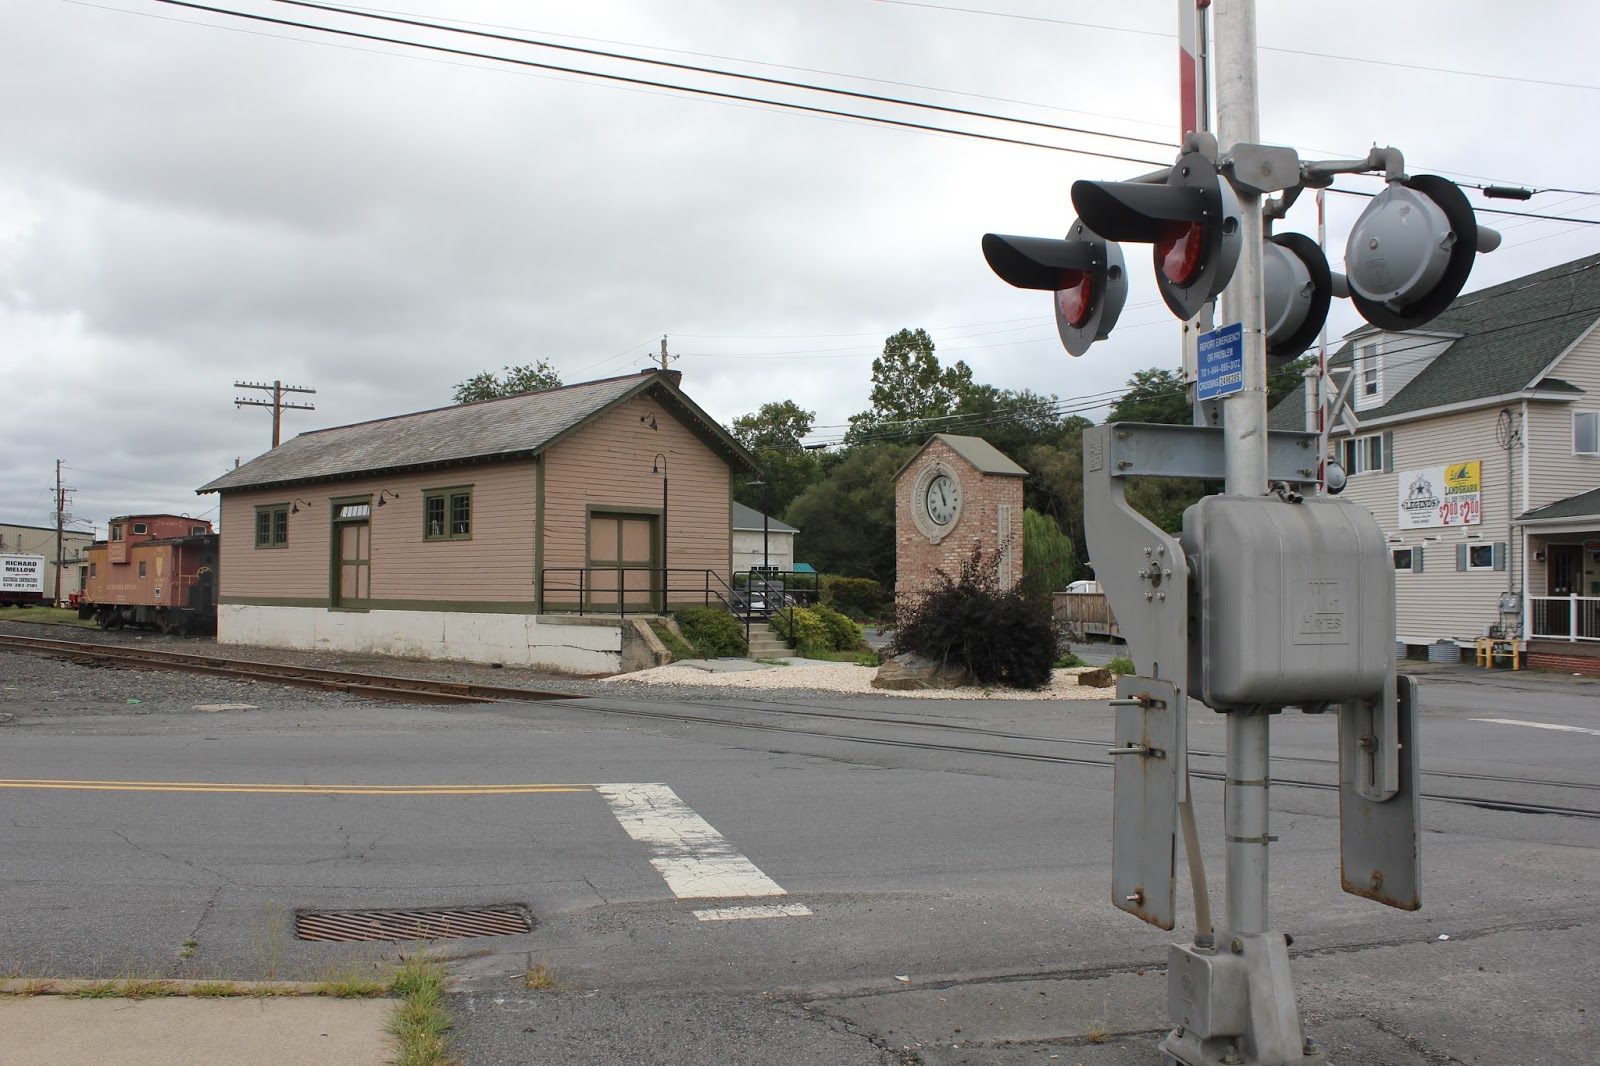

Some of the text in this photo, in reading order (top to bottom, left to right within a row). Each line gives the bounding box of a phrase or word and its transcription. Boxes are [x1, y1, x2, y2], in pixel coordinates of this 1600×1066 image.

[1199, 332, 1240, 352] REPORT EMERGENCY
[1207, 346, 1234, 363] OR PROBLEM
[1199, 377, 1219, 391] CROSSING
[1444, 484, 1478, 496] LANDSHARK
[1406, 500, 1436, 510] LEGENDS
